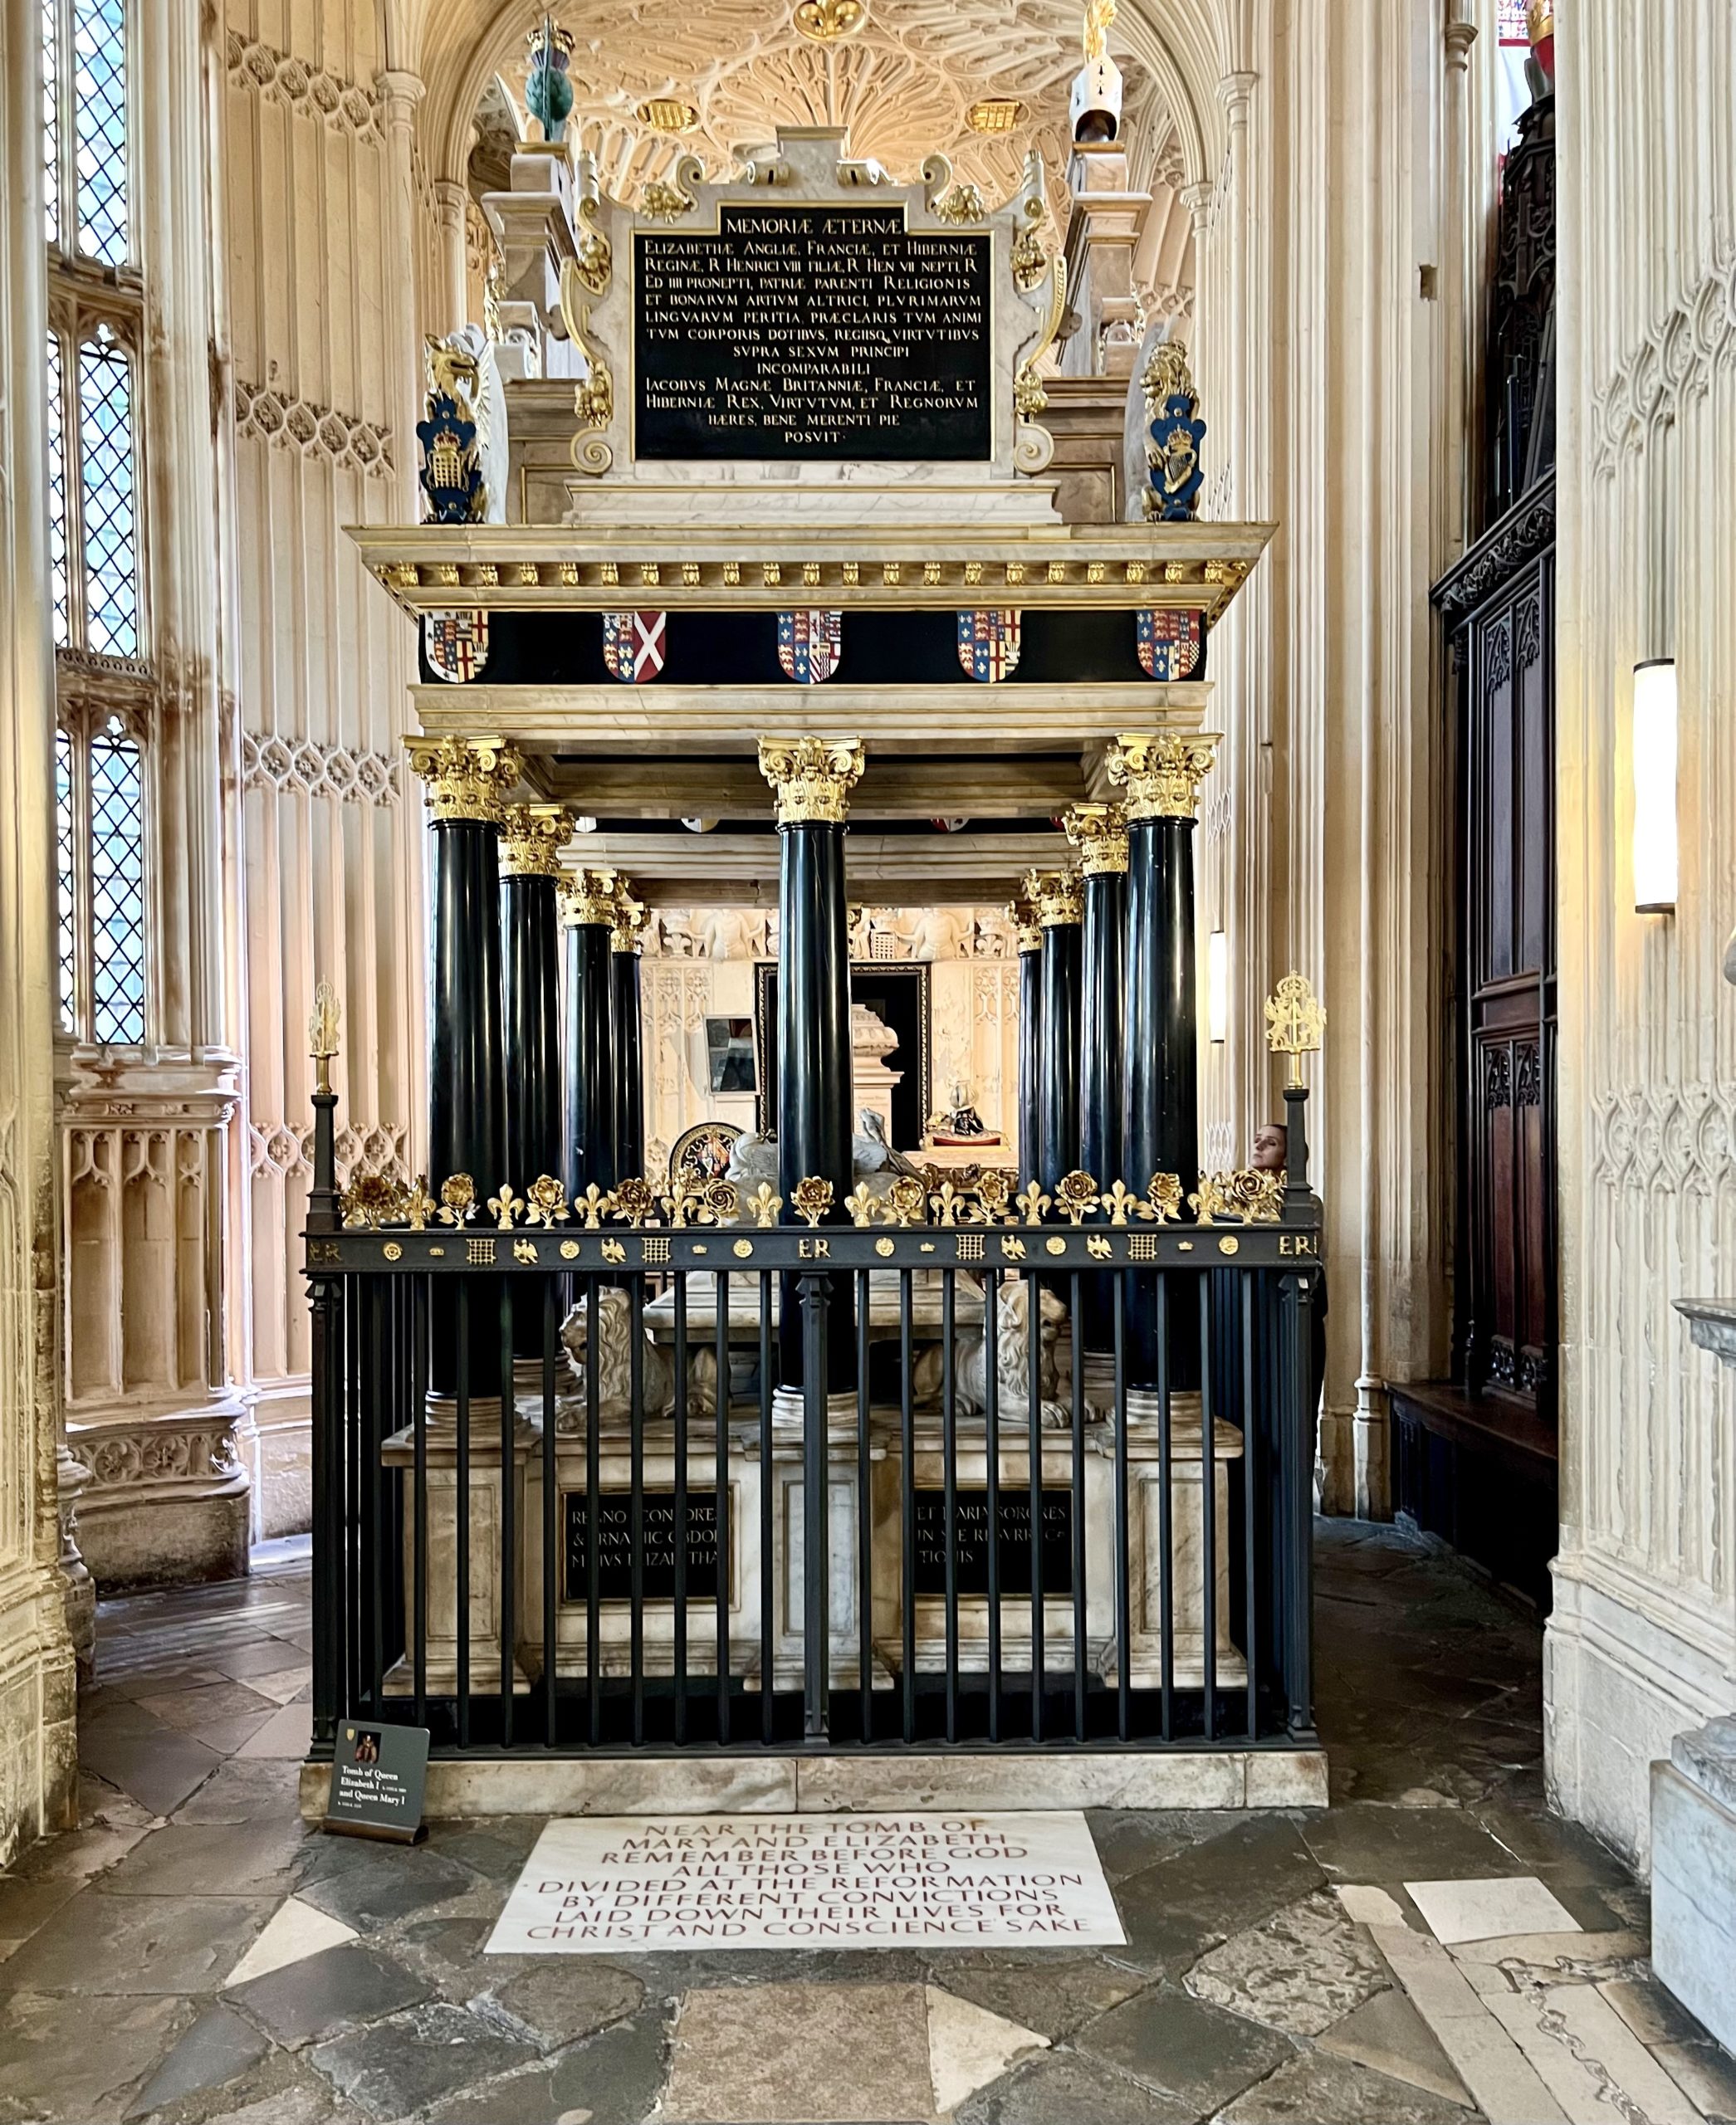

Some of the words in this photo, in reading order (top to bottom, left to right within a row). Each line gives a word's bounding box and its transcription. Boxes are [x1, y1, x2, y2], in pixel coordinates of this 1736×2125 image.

[726, 218, 814, 235] MEMORIÆ
[822, 218, 902, 235] ÆTERNÆ
[744, 239, 801, 256] ANGLIÆ,
[807, 239, 875, 256] FRANCIÆ,
[883, 239, 901, 256] ET
[907, 239, 978, 256] HIBERNIÆ
[645, 256, 704, 273] REGINÆ,
[709, 256, 721, 273] R
[726, 256, 780, 273] HENRICI
[783, 256, 801, 273] VIII
[808, 256, 845, 273] FILIÆ,
[847, 256, 861, 273] R
[867, 256, 895, 273] HEN
[900, 256, 914, 273] VII
[922, 256, 961, 273] NEPTI,
[965, 256, 979, 273] R
[645, 275, 663, 291] ED
[668, 275, 682, 291] IIII
[687, 275, 754, 291] PRONEPTI,
[760, 275, 806, 291] PATRIÆ
[814, 275, 873, 291] PARENTI
[884, 275, 971, 291] RELIGIONIS
[645, 294, 662, 306] ET
[670, 294, 738, 306] BONARVM
[746, 294, 799, 306] ARTIVM
[807, 294, 869, 306] ALTRICI,
[878, 294, 981, 306] PLVRIMARVM
[645, 310, 734, 325] LINGVARVM
[810, 310, 897, 325] PRÆCLARIS
[903, 310, 936, 325] TVM
[942, 310, 981, 325] ANIMI
[646, 329, 679, 341] TVM
[687, 329, 760, 341] CORPORIS
[768, 329, 829, 341] DOTIBVS,
[892, 329, 980, 341] VIRTVTIBVS
[733, 345, 780, 358] SVPRA
[788, 345, 839, 358] SEXVM
[851, 345, 909, 358] PRINCIPI
[757, 363, 871, 375] INCOMPARABILI
[646, 377, 707, 393] IACOBVS
[715, 377, 772, 393] MAGNÆ
[783, 377, 868, 393] BRITANNIÆ,
[874, 377, 945, 393] FRANCIÆ,
[956, 377, 976, 393] ET
[646, 393, 716, 410] HIBERNIÆ
[726, 393, 765, 410] REX,
[770, 393, 856, 410] VIRTVTVM,
[860, 393, 879, 410] ET
[890, 393, 979, 410] REGNORVM
[763, 414, 798, 427] BENE
[807, 414, 871, 427] MERENTI
[879, 414, 901, 427] PIE
[799, 1238, 831, 1258] ER
[572, 1510, 627, 1525] RENO
[573, 1532, 584, 1546] &
[599, 1531, 632, 1546] RNA
[917, 1528, 934, 1542] IN
[342, 1765, 364, 1776] Tomb
[364, 1768, 374, 1777] of
[374, 1769, 399, 1781] Queen
[340, 1776, 374, 1790] Elizabeth
[339, 1789, 354, 1798] and
[355, 1790, 379, 1801] Queen
[379, 1793, 400, 1807] Mary
[644, 1825, 735, 1836] NEAR
[746, 1823, 814, 1835] THE
[831, 1821, 927, 1834] TOMB
[941, 1820, 985, 1832] OF
[622, 1837, 720, 1849] MARY
[731, 1836, 809, 1849] AND
[824, 1834, 1006, 1847] ELIZABETH
[600, 1850, 800, 1864] REMEMBER
[811, 1848, 938, 1862] BEFORE
[947, 1846, 1029, 1859] GOD
[671, 1865, 730, 1877] ALL
[736, 1863, 851, 1876] THOSE
[863, 1861, 951, 1874] WHO
[538, 1879, 687, 1893] DIVIDED
[699, 1878, 743, 1891] AT
[751, 1877, 817, 1890] THE
[831, 1873, 1083, 1889] REFORMATION
[562, 1894, 604, 1908] BY
[613, 1891, 807, 1908] DIFFERENT
[817, 1888, 1059, 1905] CONVICTIONS
[555, 1909, 633, 1923] LAID
[646, 1908, 765, 1922] DOWN
[775, 1906, 882, 1921] THEIR
[896, 1905, 984, 1919] LIVES
[999, 1903, 1066, 1917] FOR
[526, 1924, 658, 1939] CHRIST
[666, 1922, 748, 1937] AND
[1006, 1917, 1093, 1932] SAKE
